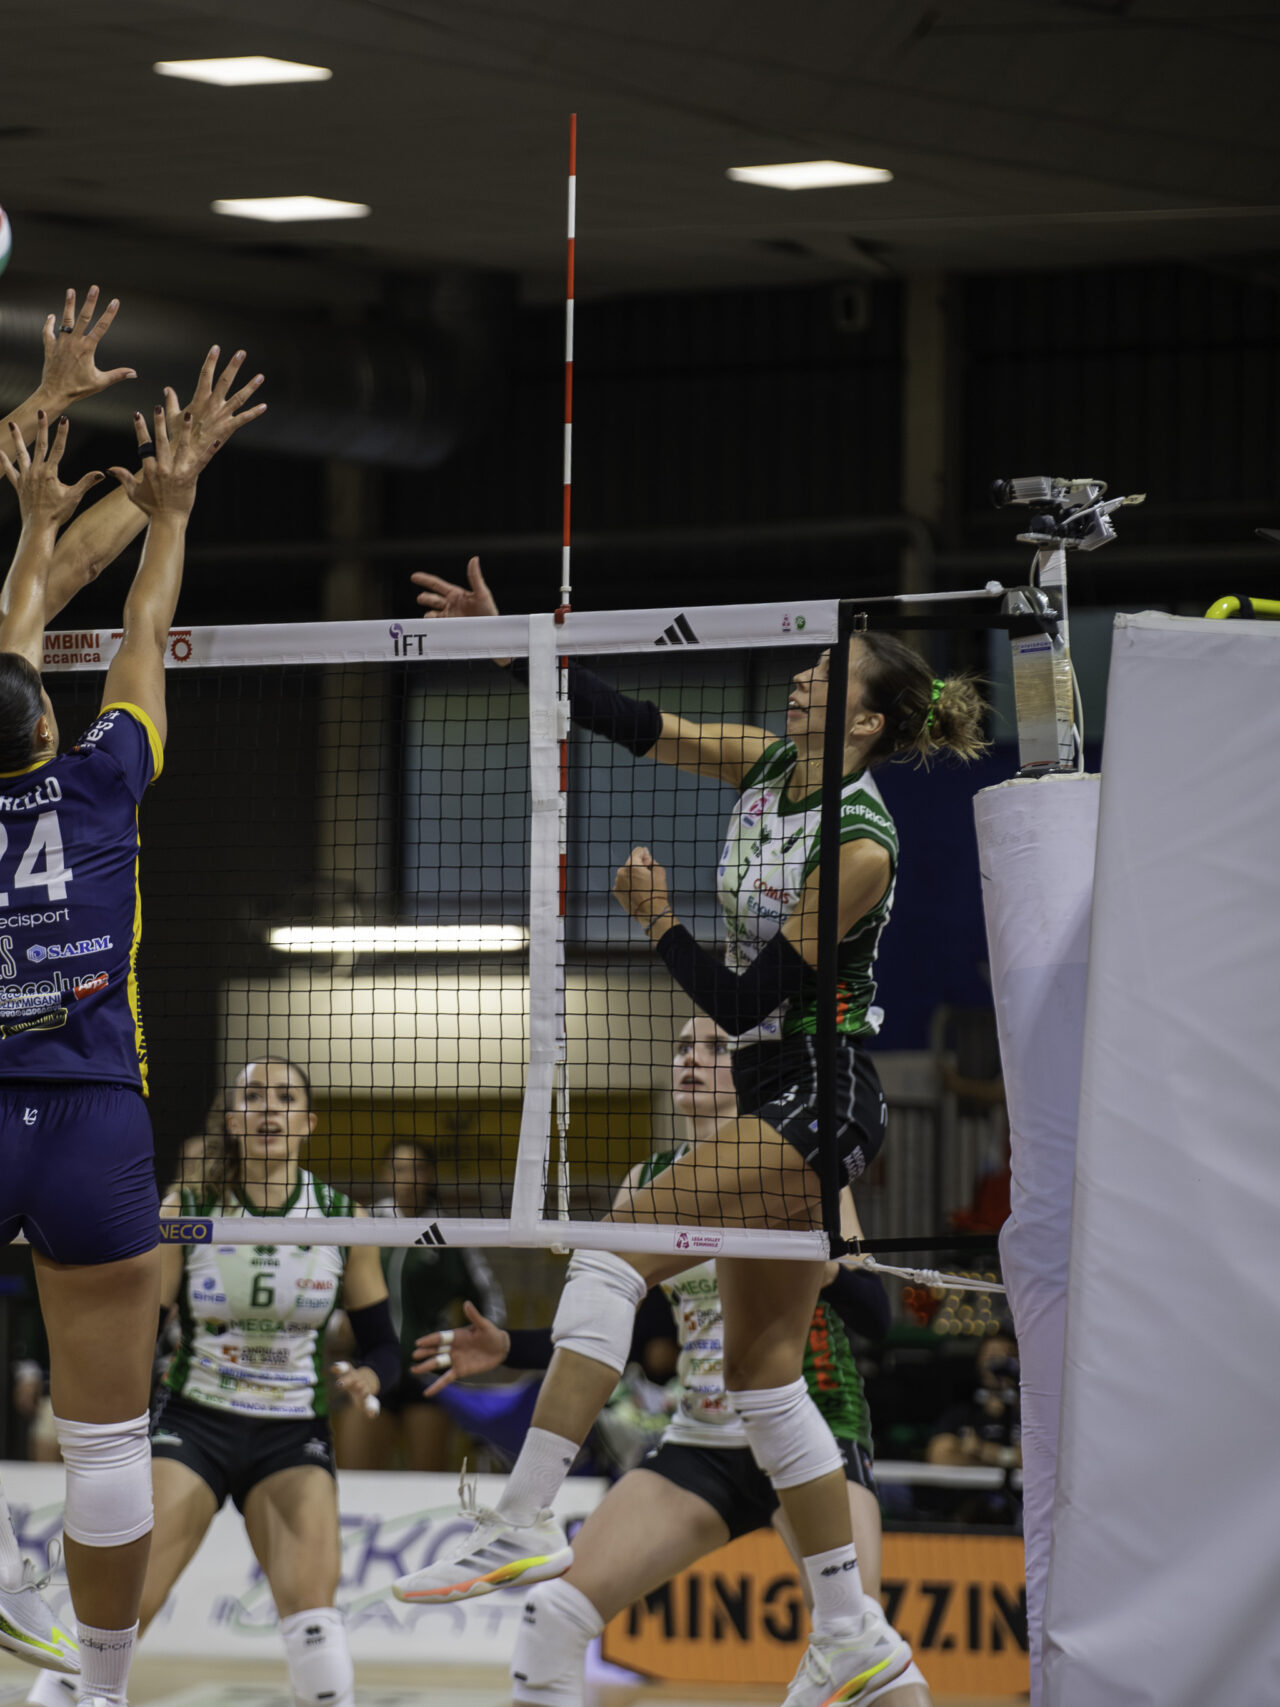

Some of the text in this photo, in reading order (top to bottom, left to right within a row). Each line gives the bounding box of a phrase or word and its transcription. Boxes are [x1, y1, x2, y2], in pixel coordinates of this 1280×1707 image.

[43, 633, 100, 650] MBINI
[43, 652, 101, 664] ccanica
[160, 1224, 208, 1240] NECO
[251, 1272, 277, 1308] 6
